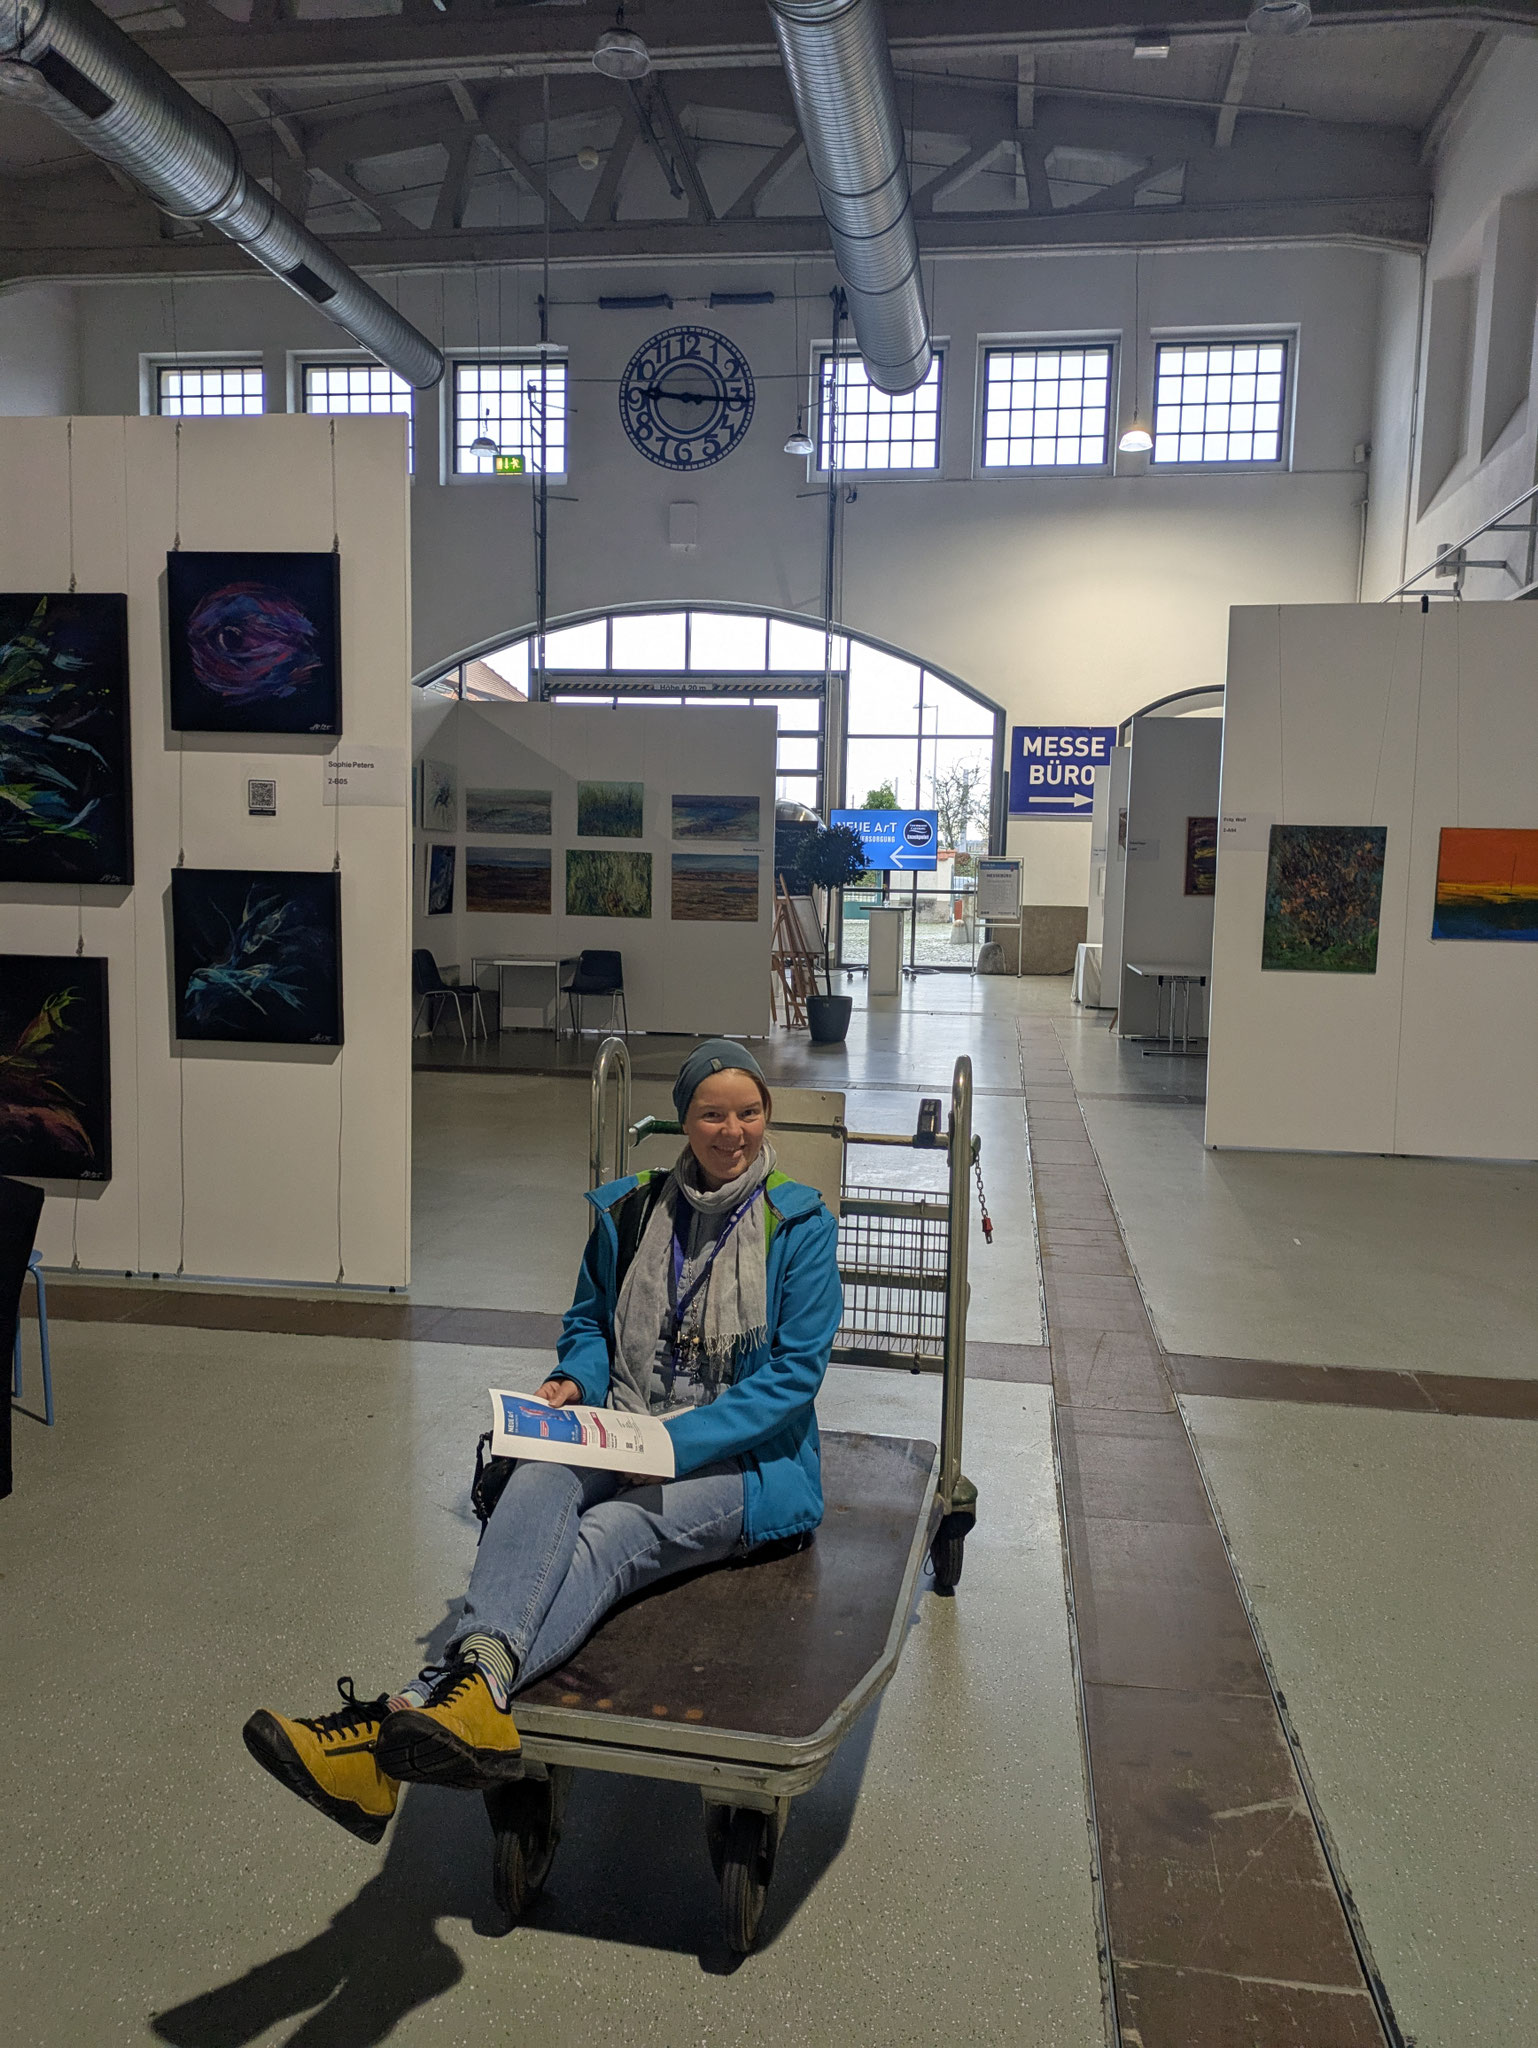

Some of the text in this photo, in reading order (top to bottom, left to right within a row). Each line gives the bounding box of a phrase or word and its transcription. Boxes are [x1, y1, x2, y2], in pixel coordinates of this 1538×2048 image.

[652, 340, 671, 363] 11
[676, 334, 701, 357] 12
[709, 342, 719, 364] 1
[636, 359, 656, 381] 10
[724, 359, 741, 382] 2
[628, 387, 647, 412] 9
[727, 387, 746, 412] 3
[636, 412, 653, 440] 8
[720, 414, 735, 441] 4
[656, 437, 670, 458] 7
[674, 442, 692, 462] 6
[703, 434, 721, 456] 5
[1023, 737, 1106, 757] MESSE
[328, 761, 374, 769] Sophie Peters
[1029, 760, 1095, 785] BÜRO
